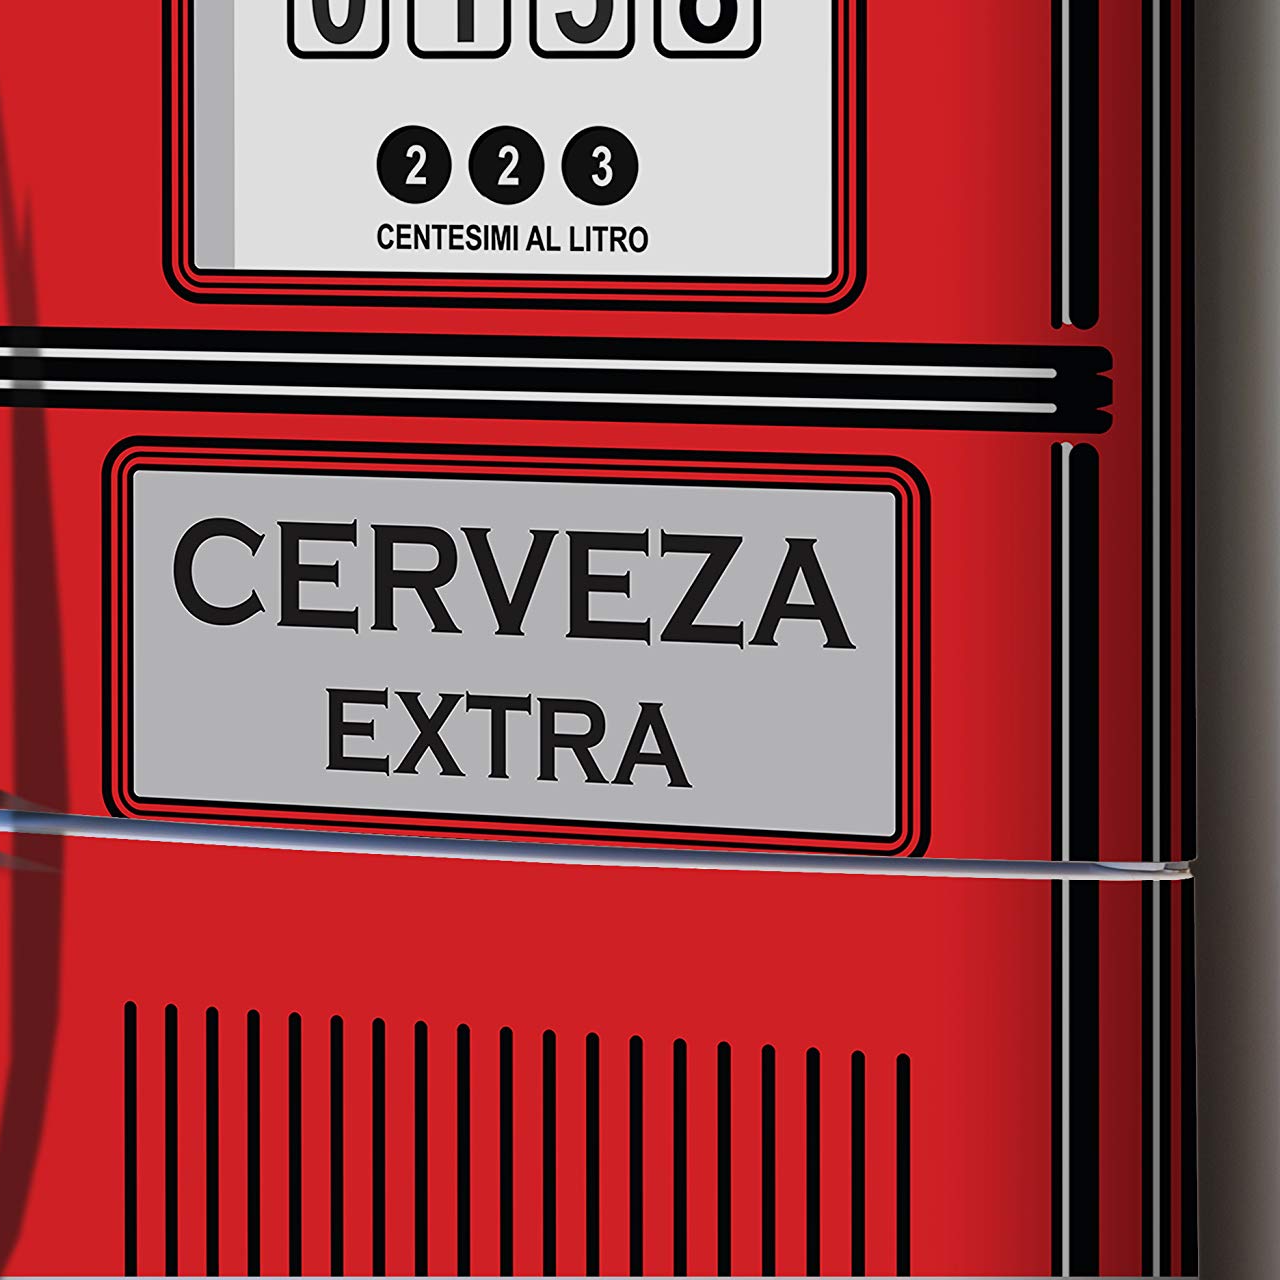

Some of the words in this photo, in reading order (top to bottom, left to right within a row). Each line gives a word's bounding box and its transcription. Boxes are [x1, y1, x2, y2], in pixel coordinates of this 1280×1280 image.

[376, 223, 519, 252] CENTESIMI
[525, 225, 562, 252] AL
[569, 225, 650, 253] LITRO
[172, 517, 857, 650] CERVEZA
[325, 687, 693, 789] EXTRA
